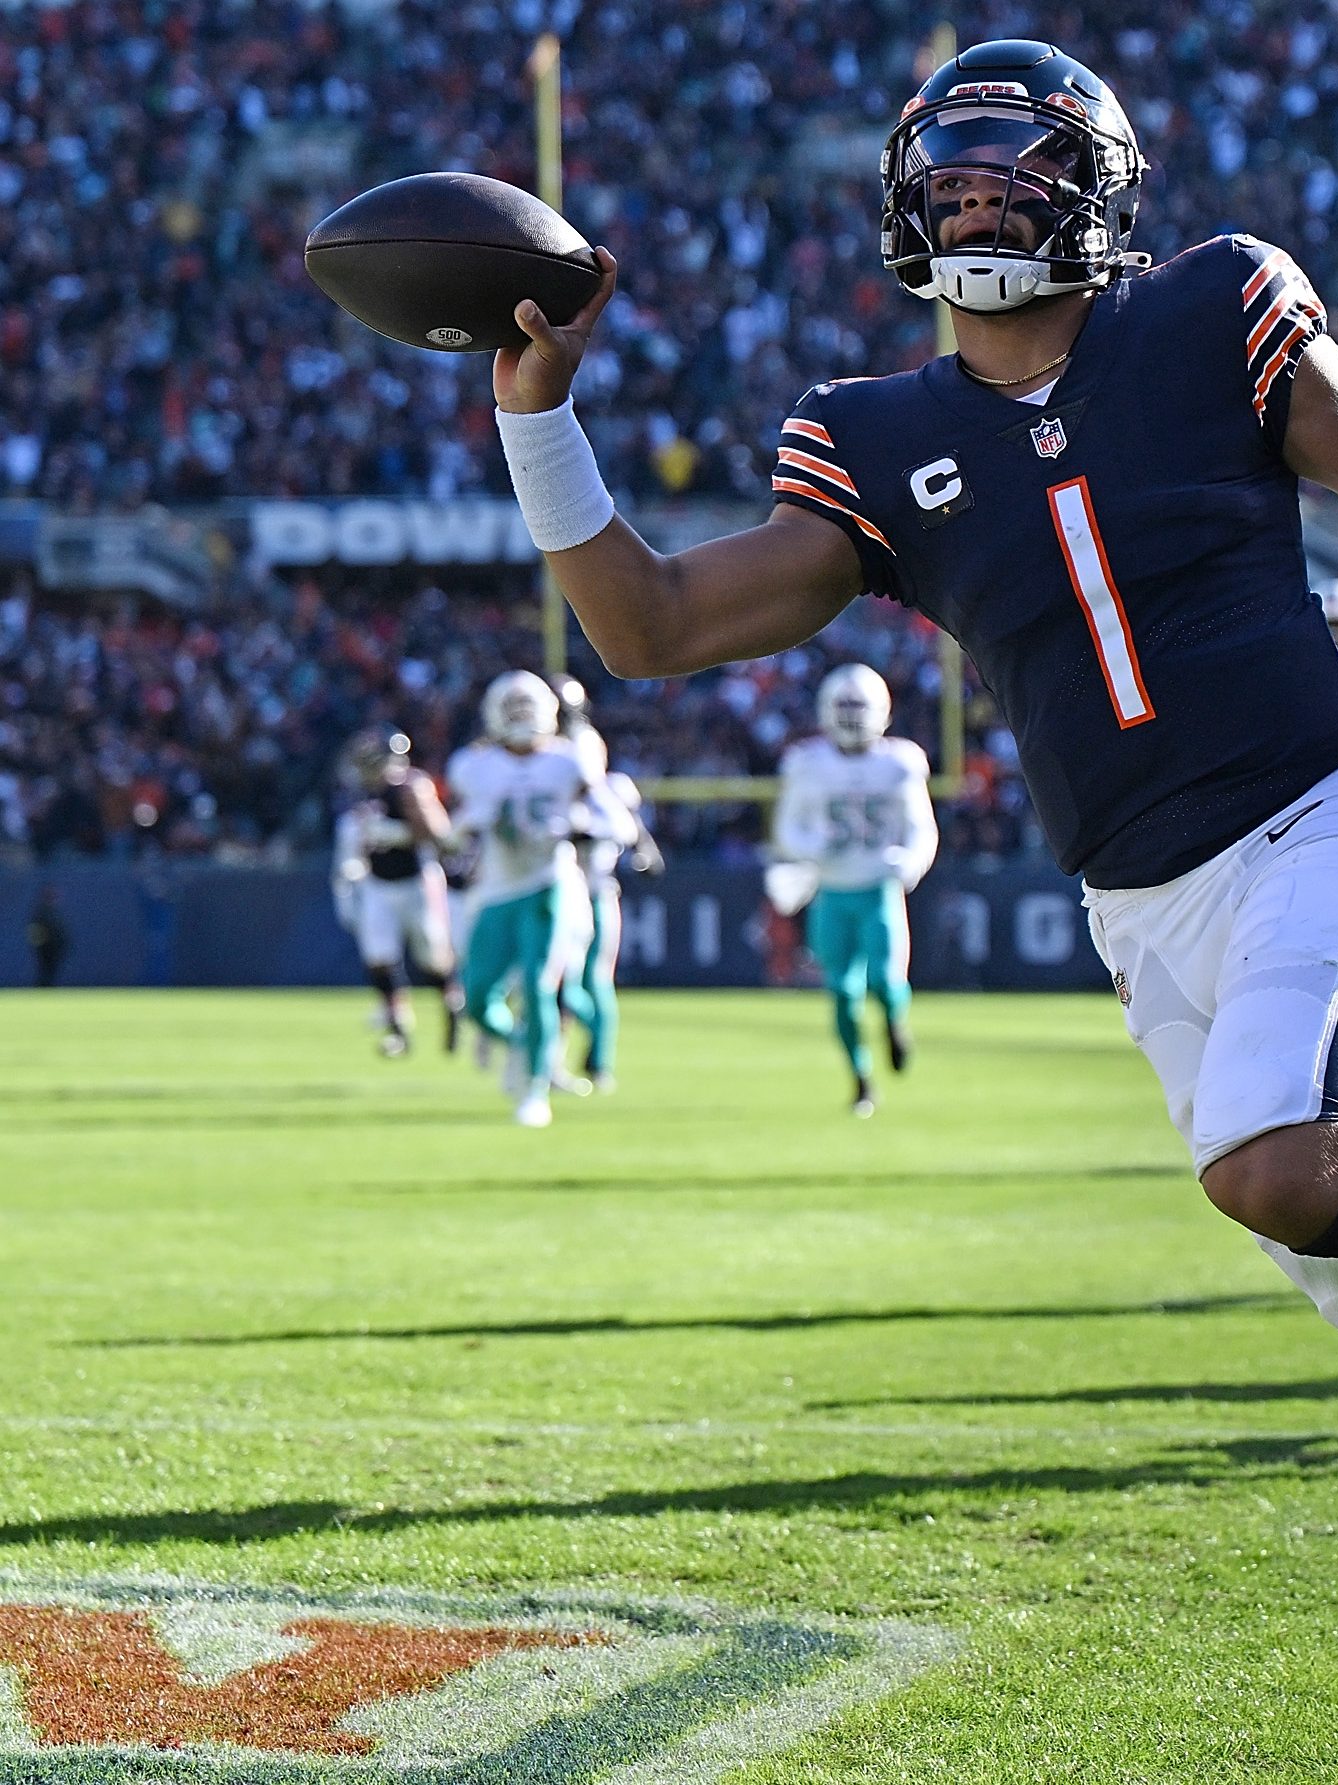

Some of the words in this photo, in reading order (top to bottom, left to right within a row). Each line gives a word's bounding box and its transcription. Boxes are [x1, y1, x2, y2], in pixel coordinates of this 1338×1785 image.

[957, 85, 1016, 95] BEARS
[1039, 434, 1062, 453] NFL
[910, 457, 962, 510] C
[1047, 475, 1156, 730] 1
